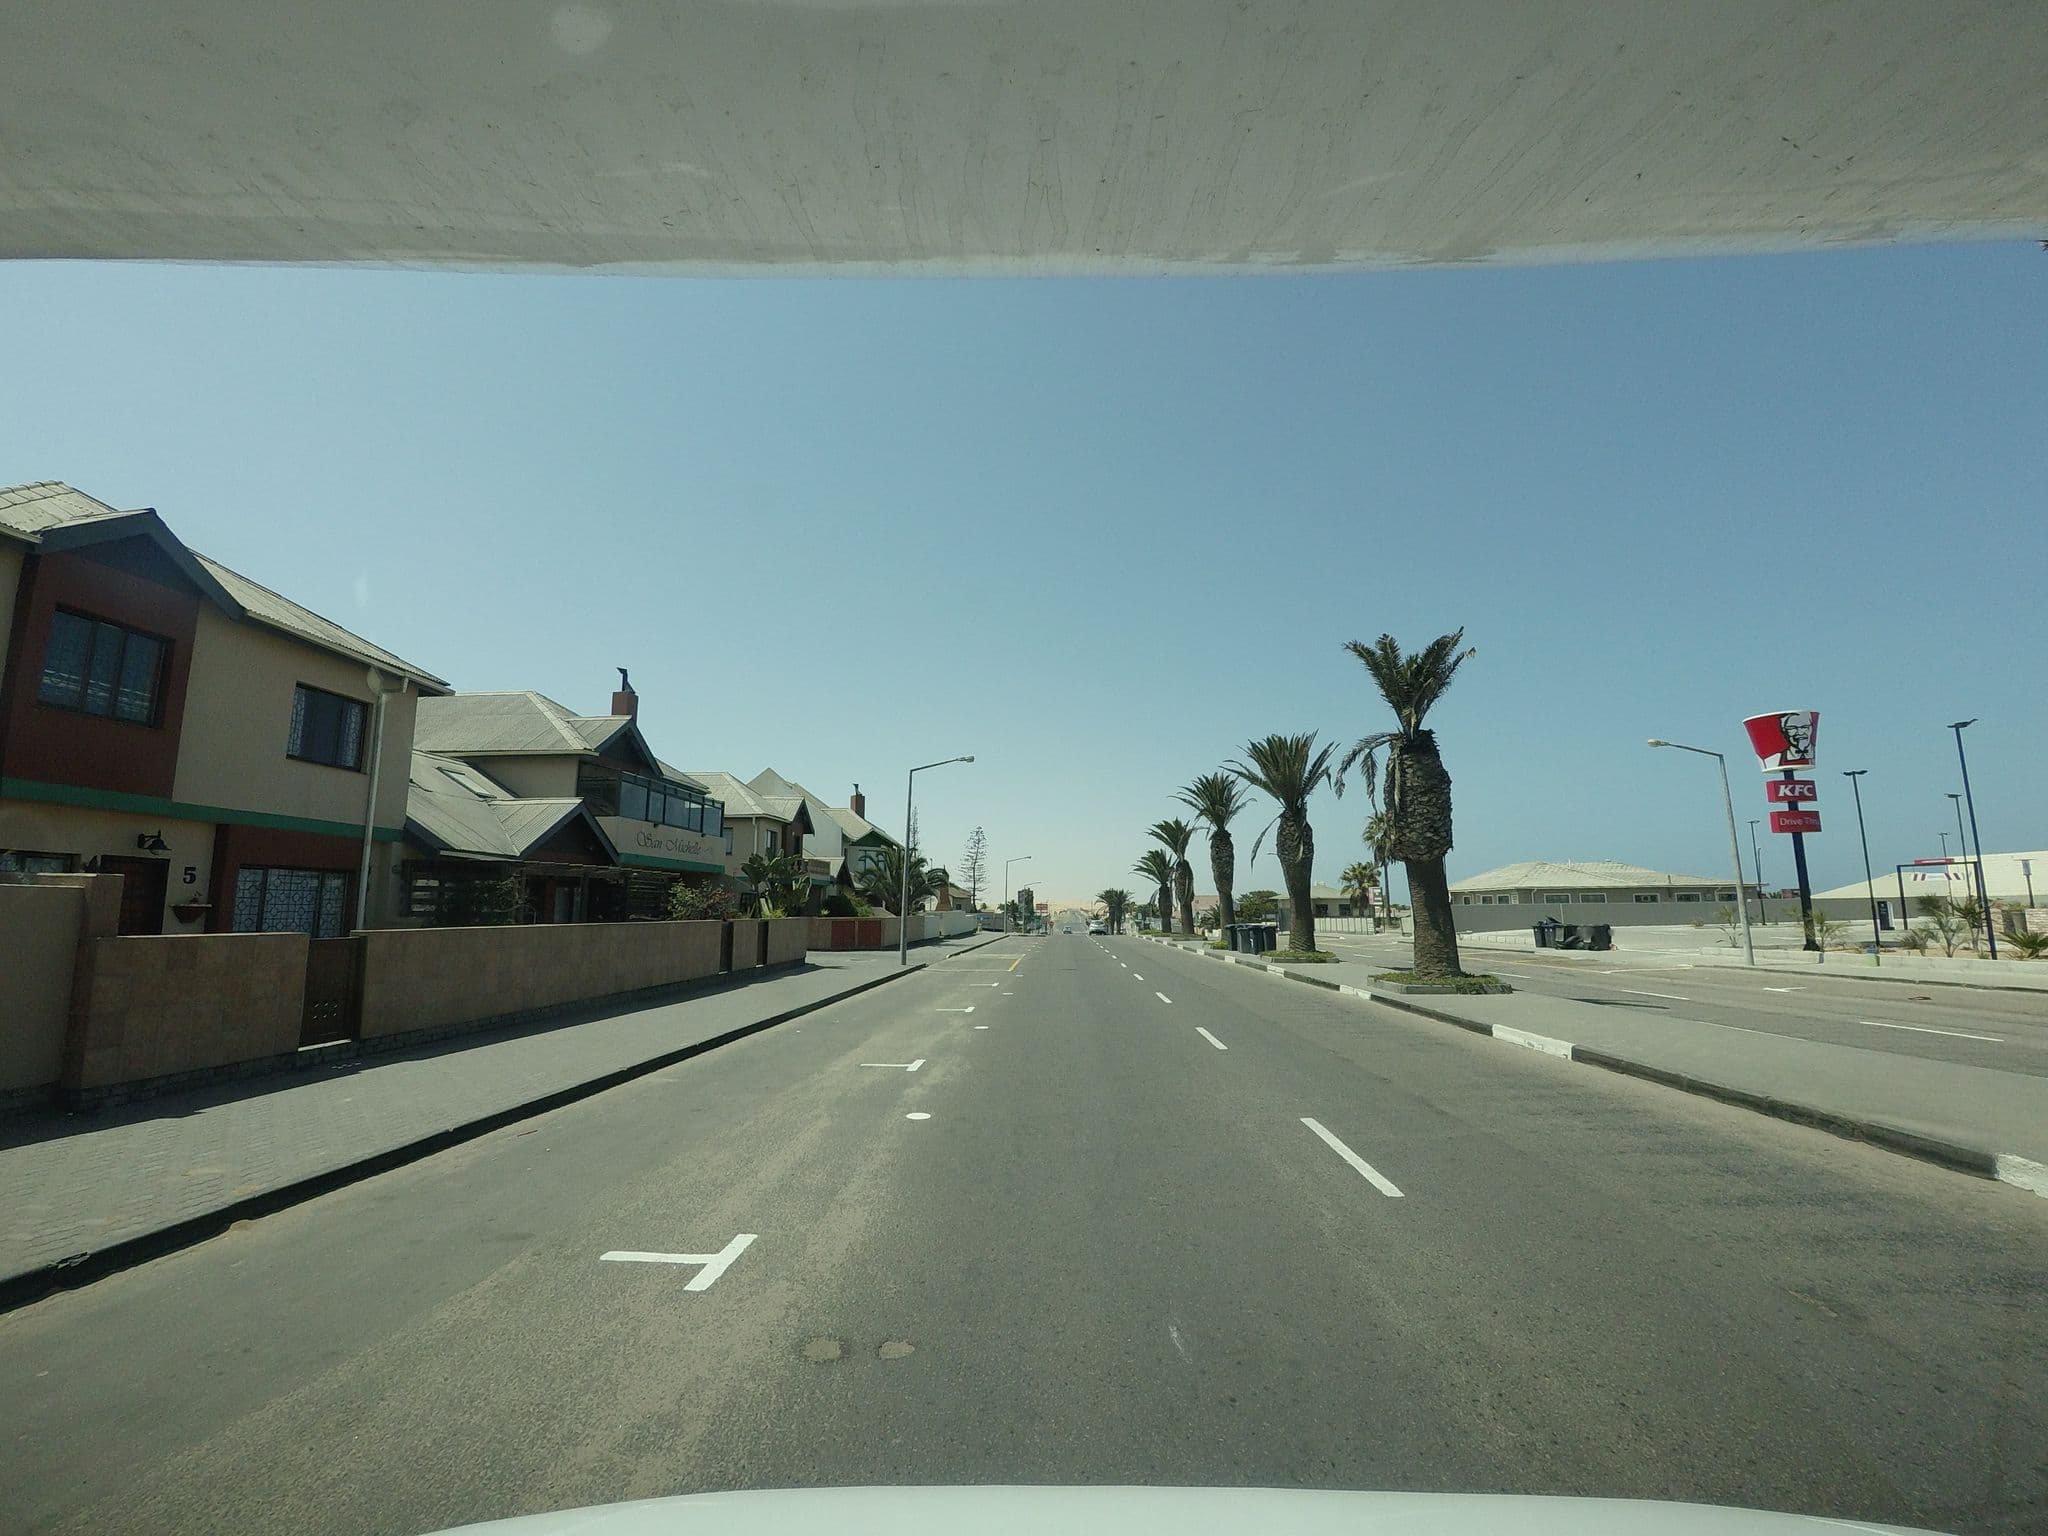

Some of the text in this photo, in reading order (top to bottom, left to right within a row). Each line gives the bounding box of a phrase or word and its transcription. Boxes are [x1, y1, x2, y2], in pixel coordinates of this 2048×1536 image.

[1778, 784, 1813, 797] KFC
[1779, 817, 1803, 826] Drive
[636, 831, 662, 849] San
[182, 867, 196, 885] 5
